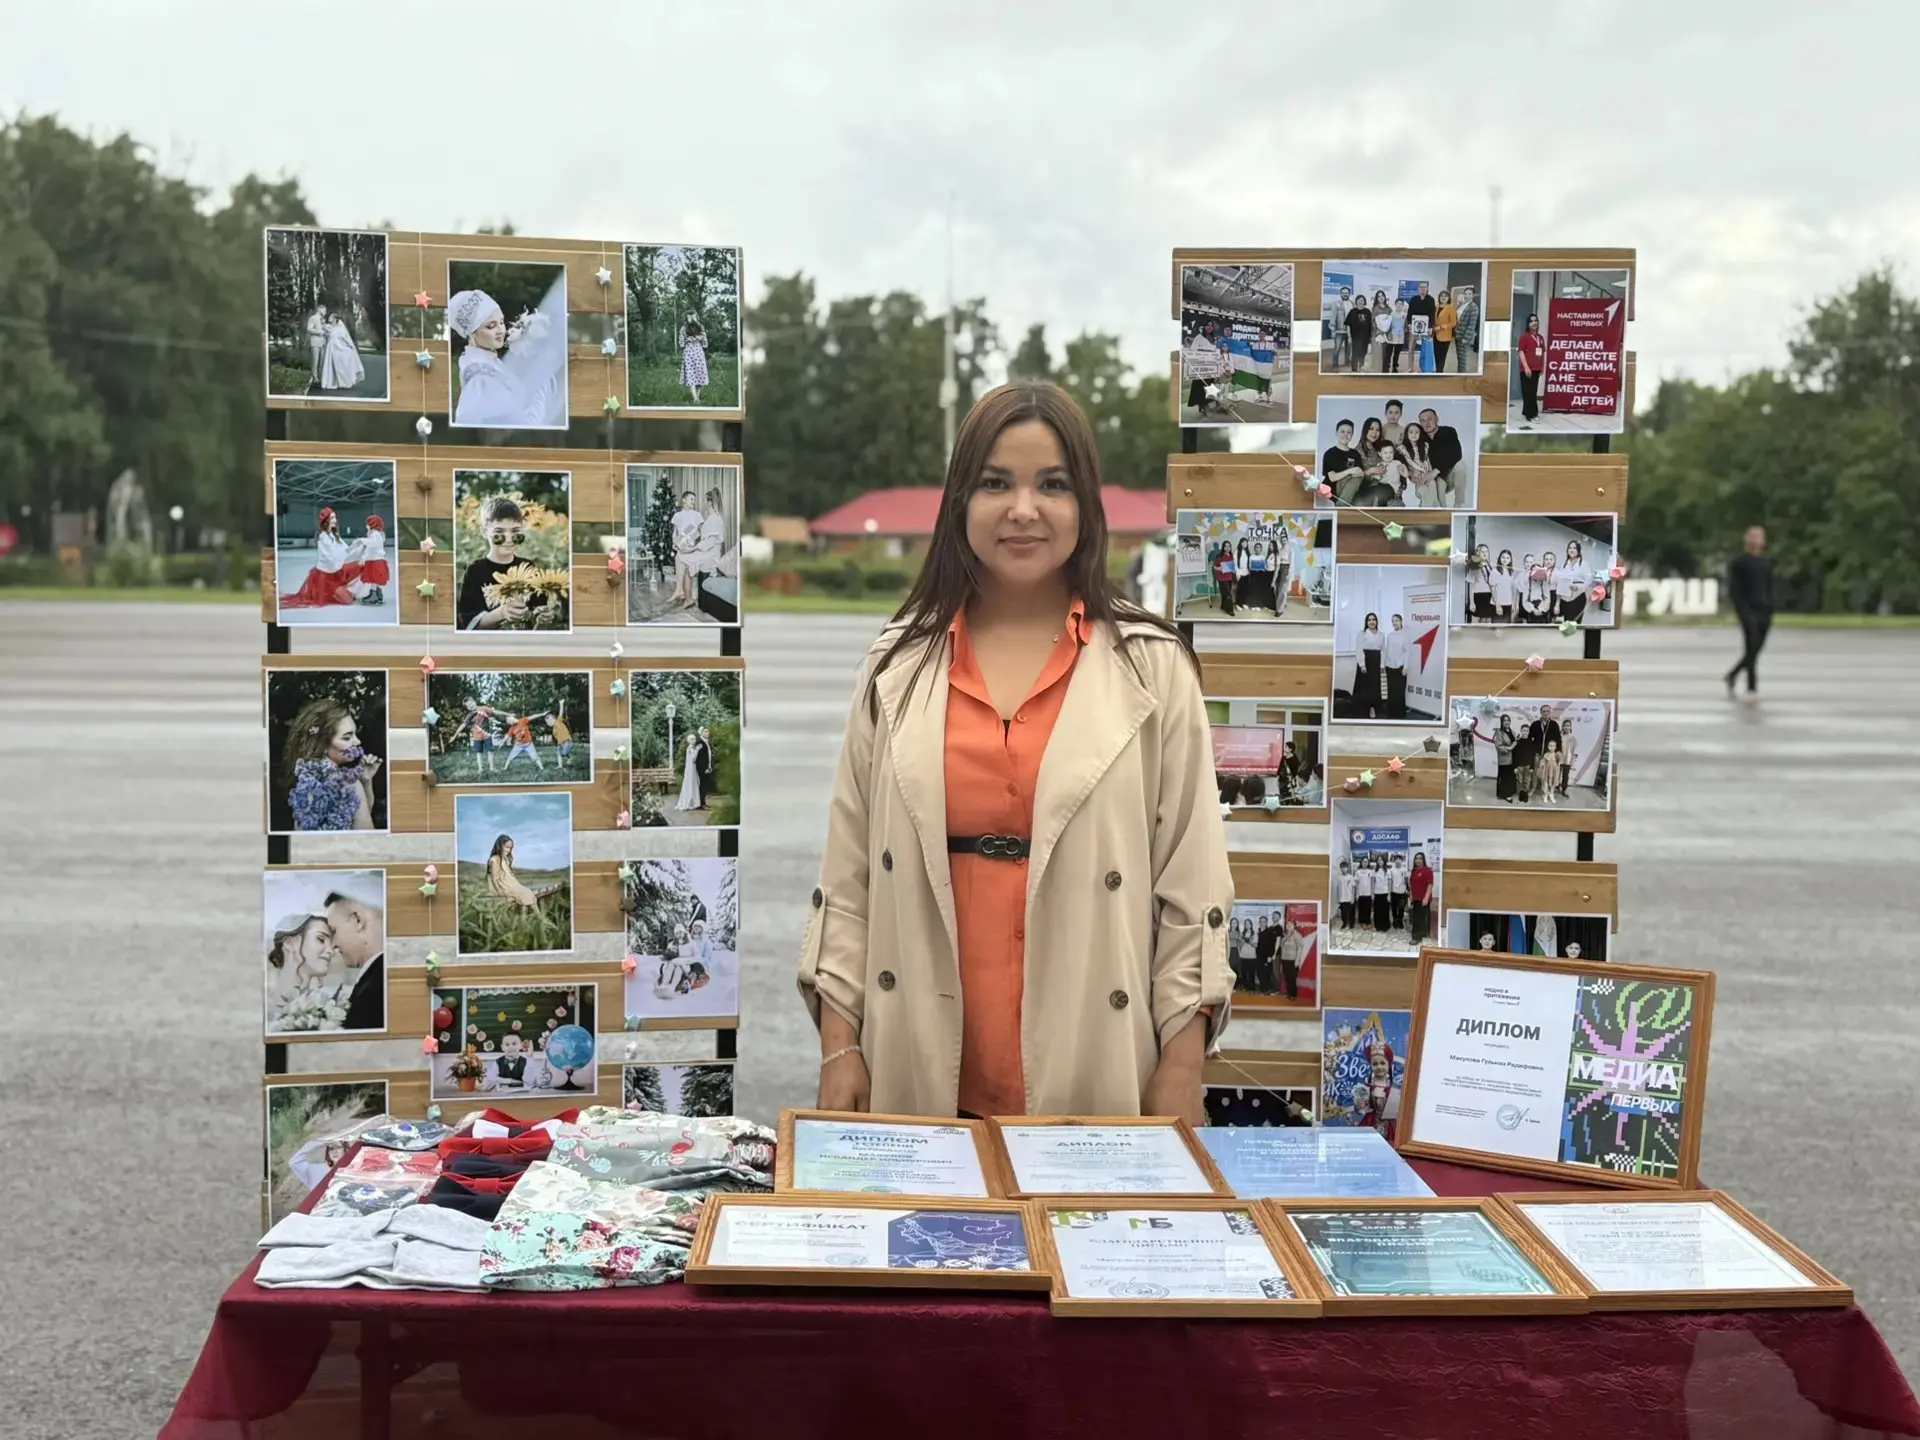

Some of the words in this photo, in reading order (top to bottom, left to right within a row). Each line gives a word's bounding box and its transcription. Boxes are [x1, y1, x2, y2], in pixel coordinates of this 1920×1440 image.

[1557, 312, 1604, 320] НАСТАВНИК
[1549, 340, 1604, 350] ДЕЛАЕМ
[1565, 351, 1617, 361] ВМЕСТЕ
[1549, 361, 1557, 370] С
[1559, 361, 1617, 373] ДЕТЬМИ,
[1549, 373, 1557, 382] А
[1559, 373, 1576, 382] НЕ
[1547, 384, 1600, 394] ВМЕСТО
[1571, 394, 1615, 406] ДЕТЕЙ
[1248, 525, 1289, 539] ТОЧКА
[1411, 613, 1441, 623] Первые
[1455, 1018, 1541, 1041] ДИПЛОМ
[1572, 1054, 1680, 1092] МЕДИА
[1610, 1093, 1677, 1114] ПЕРВЫХ
[839, 1134, 929, 1145] ДИПЛОМ
[735, 1220, 869, 1230] СЕРТИФИКАТ
